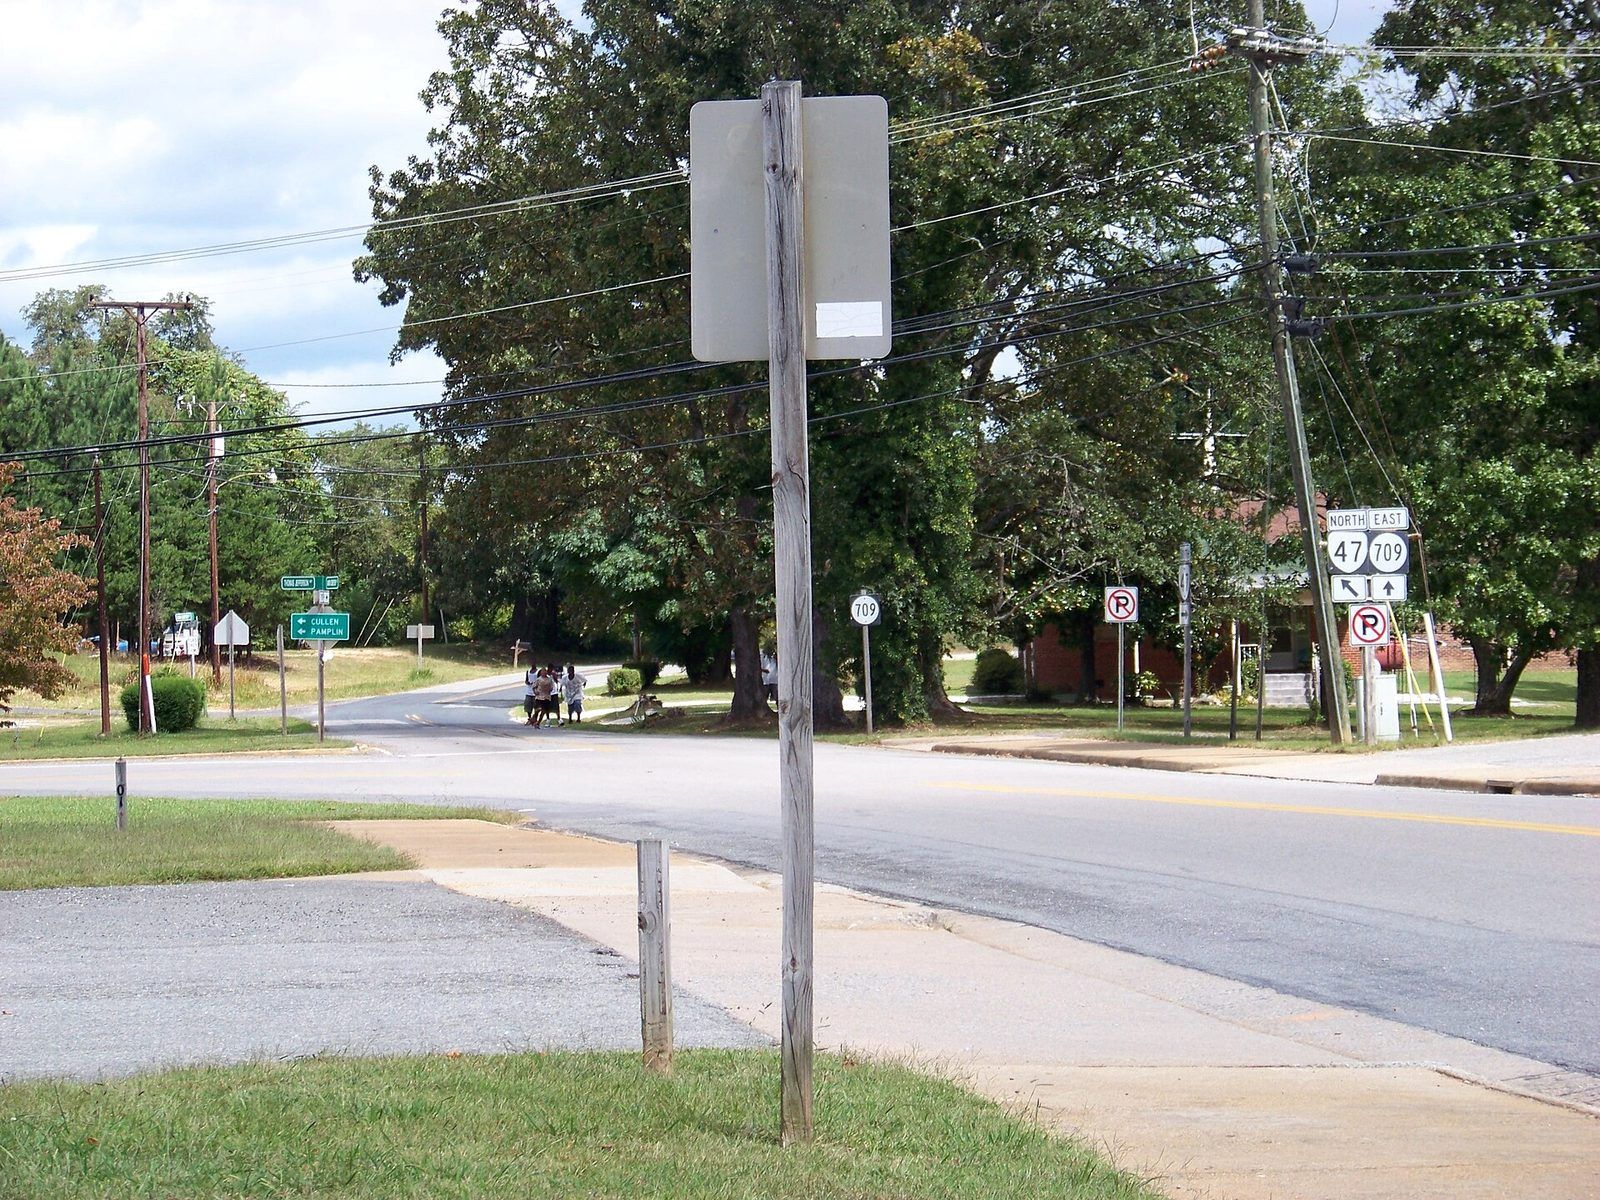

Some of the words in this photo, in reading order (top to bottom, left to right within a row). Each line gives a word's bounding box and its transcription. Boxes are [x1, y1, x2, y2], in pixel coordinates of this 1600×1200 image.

[1330, 514, 1365, 527] NORTH
[1375, 512, 1401, 525] EAST
[1334, 541, 1362, 562] 47
[1374, 543, 1402, 561] 709
[855, 603, 876, 617] 709
[311, 618, 339, 626] CULLEN
[311, 628, 343, 636] PAMPLIN
